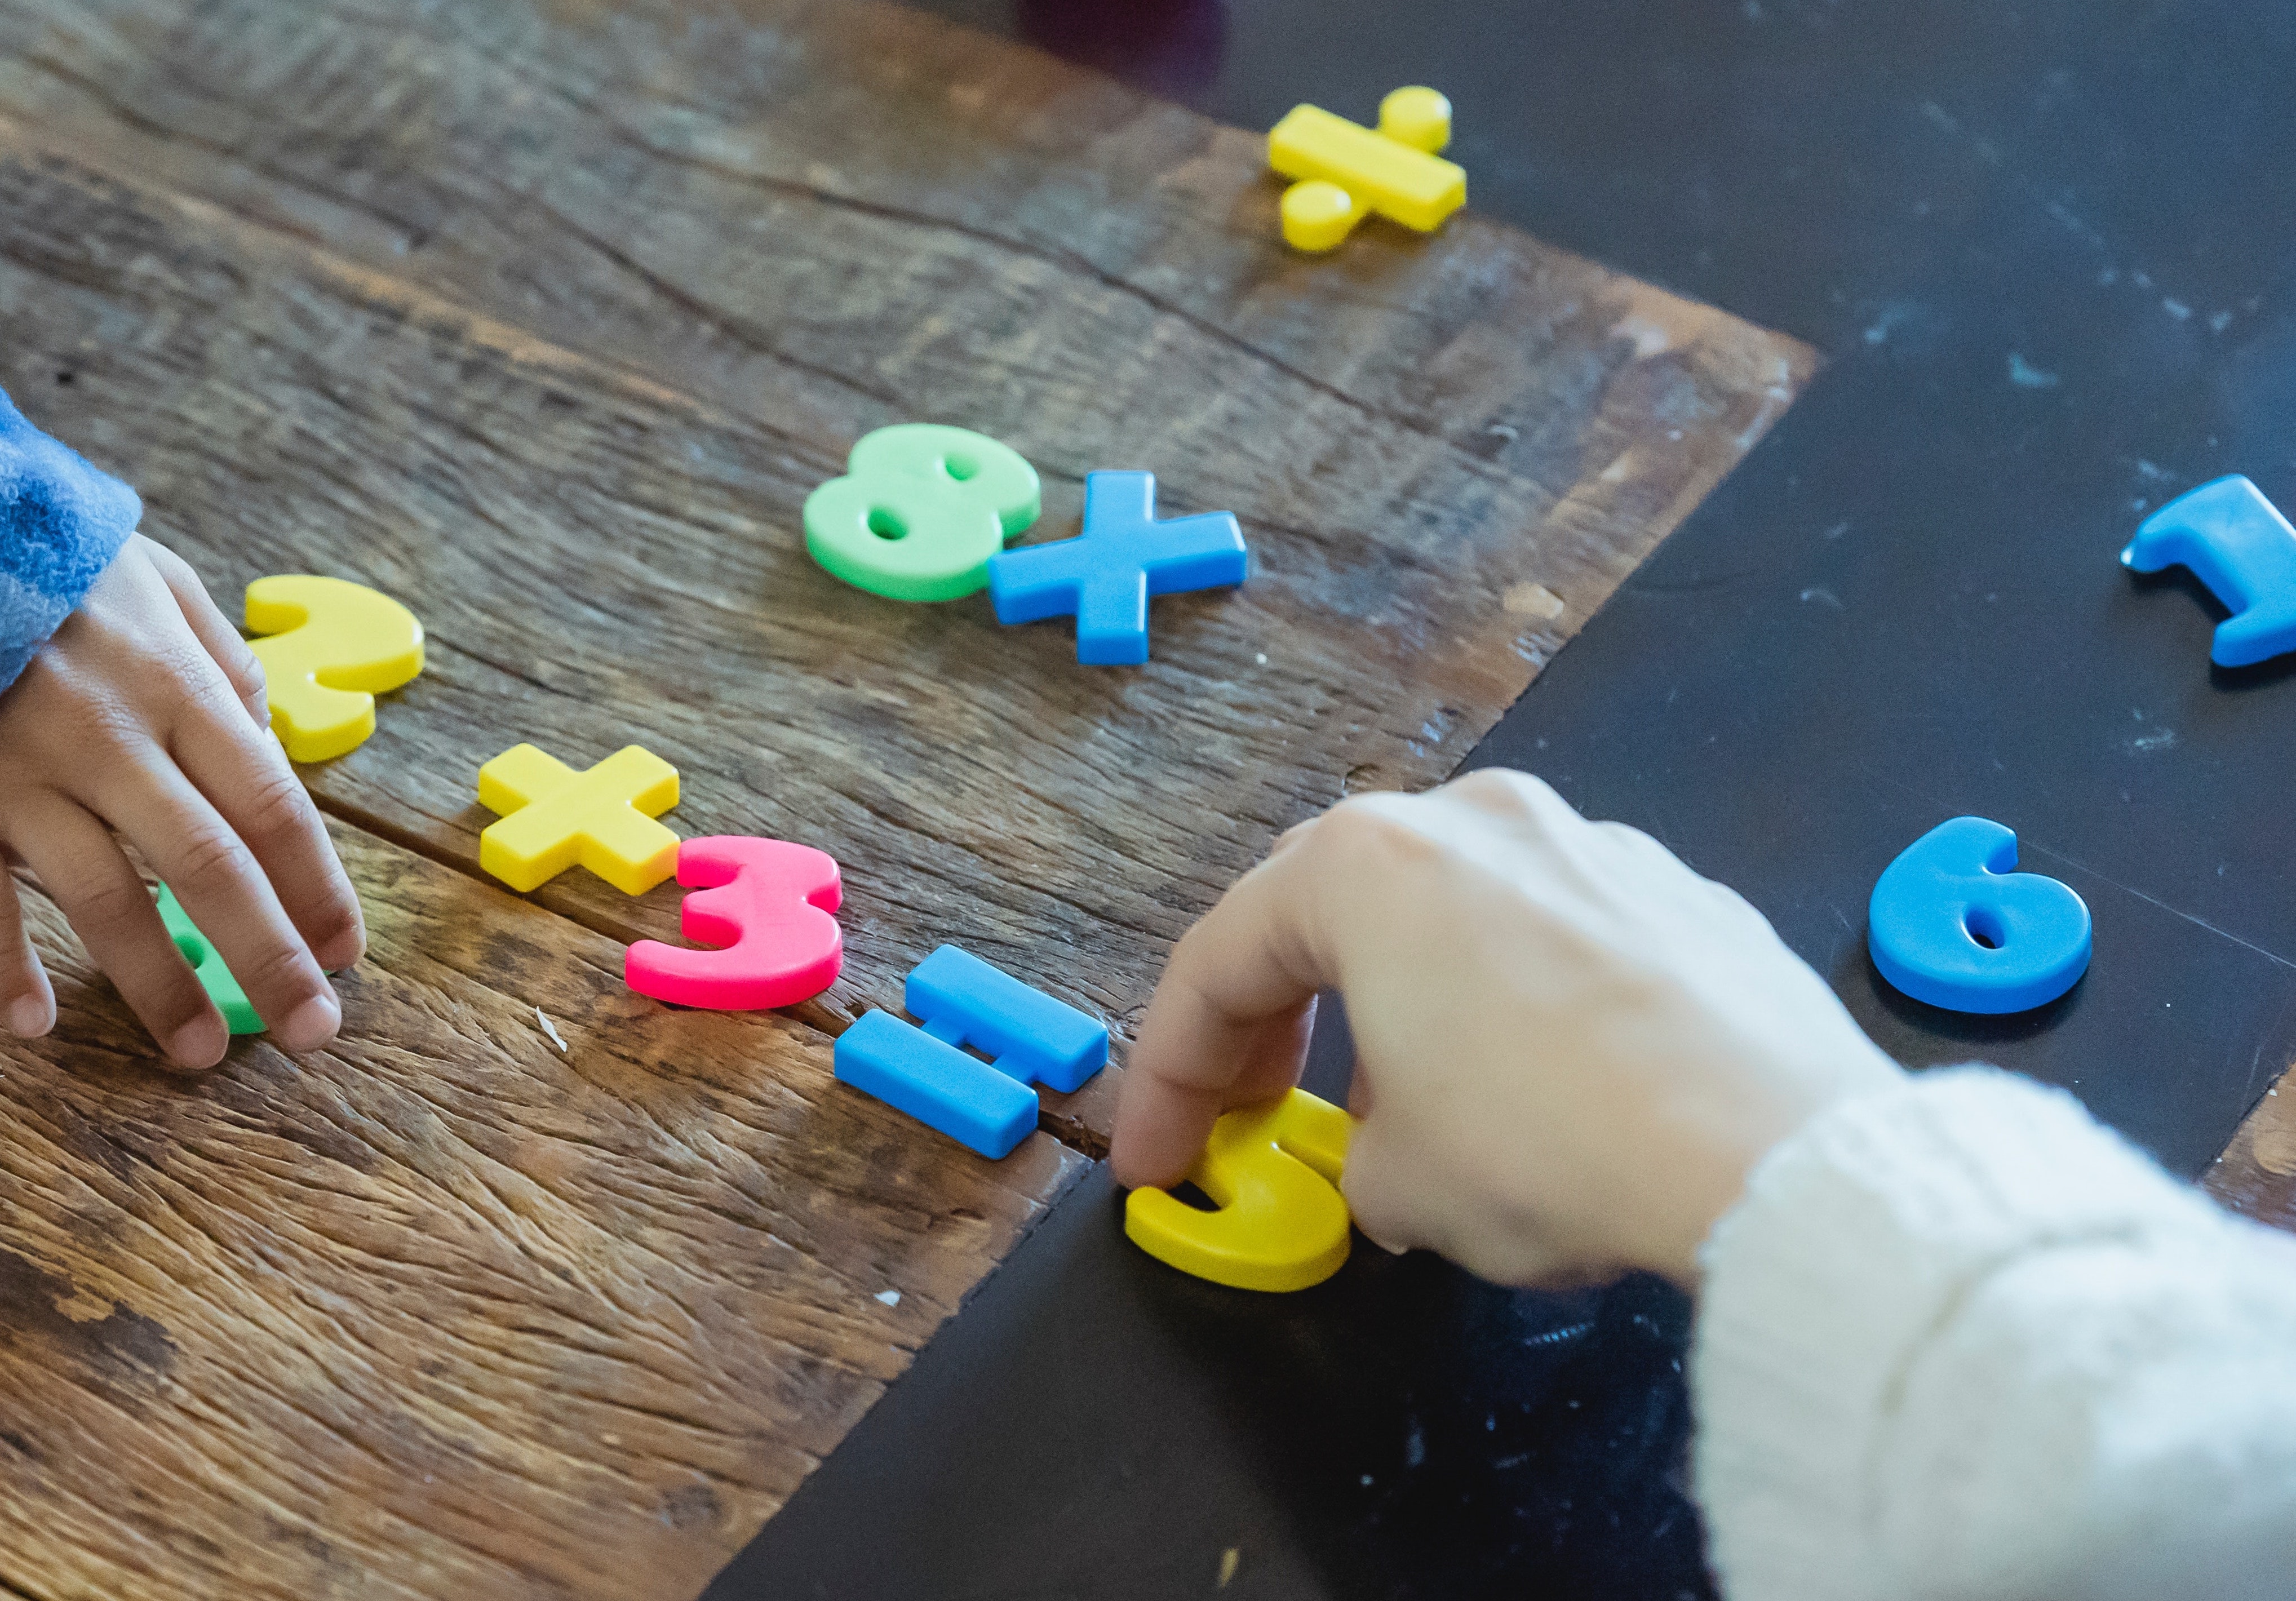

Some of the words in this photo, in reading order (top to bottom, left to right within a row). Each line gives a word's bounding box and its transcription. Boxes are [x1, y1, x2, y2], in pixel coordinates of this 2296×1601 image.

[804, 423, 1040, 602] 8
[625, 836, 843, 1010] 3
[1869, 815, 2092, 1014] 6
